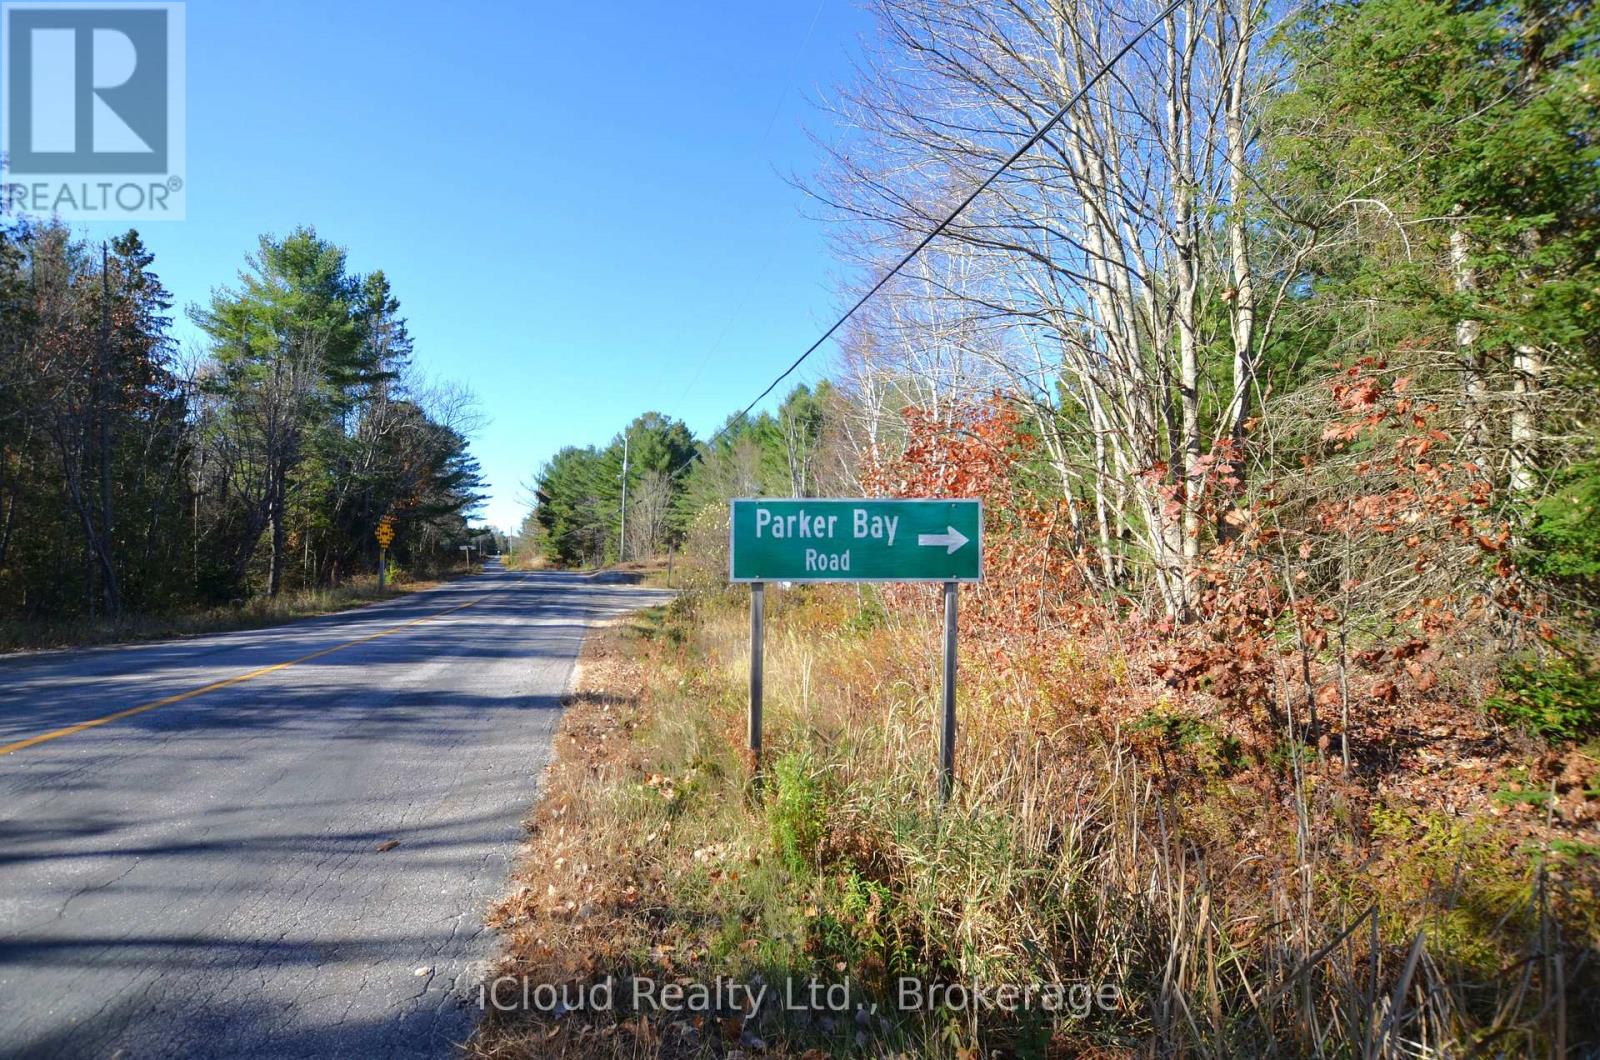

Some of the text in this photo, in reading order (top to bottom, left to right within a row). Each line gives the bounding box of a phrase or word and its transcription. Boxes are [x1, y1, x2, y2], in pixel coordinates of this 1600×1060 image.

[755, 508, 899, 546] Parker Bay
[805, 549, 850, 571] Road
